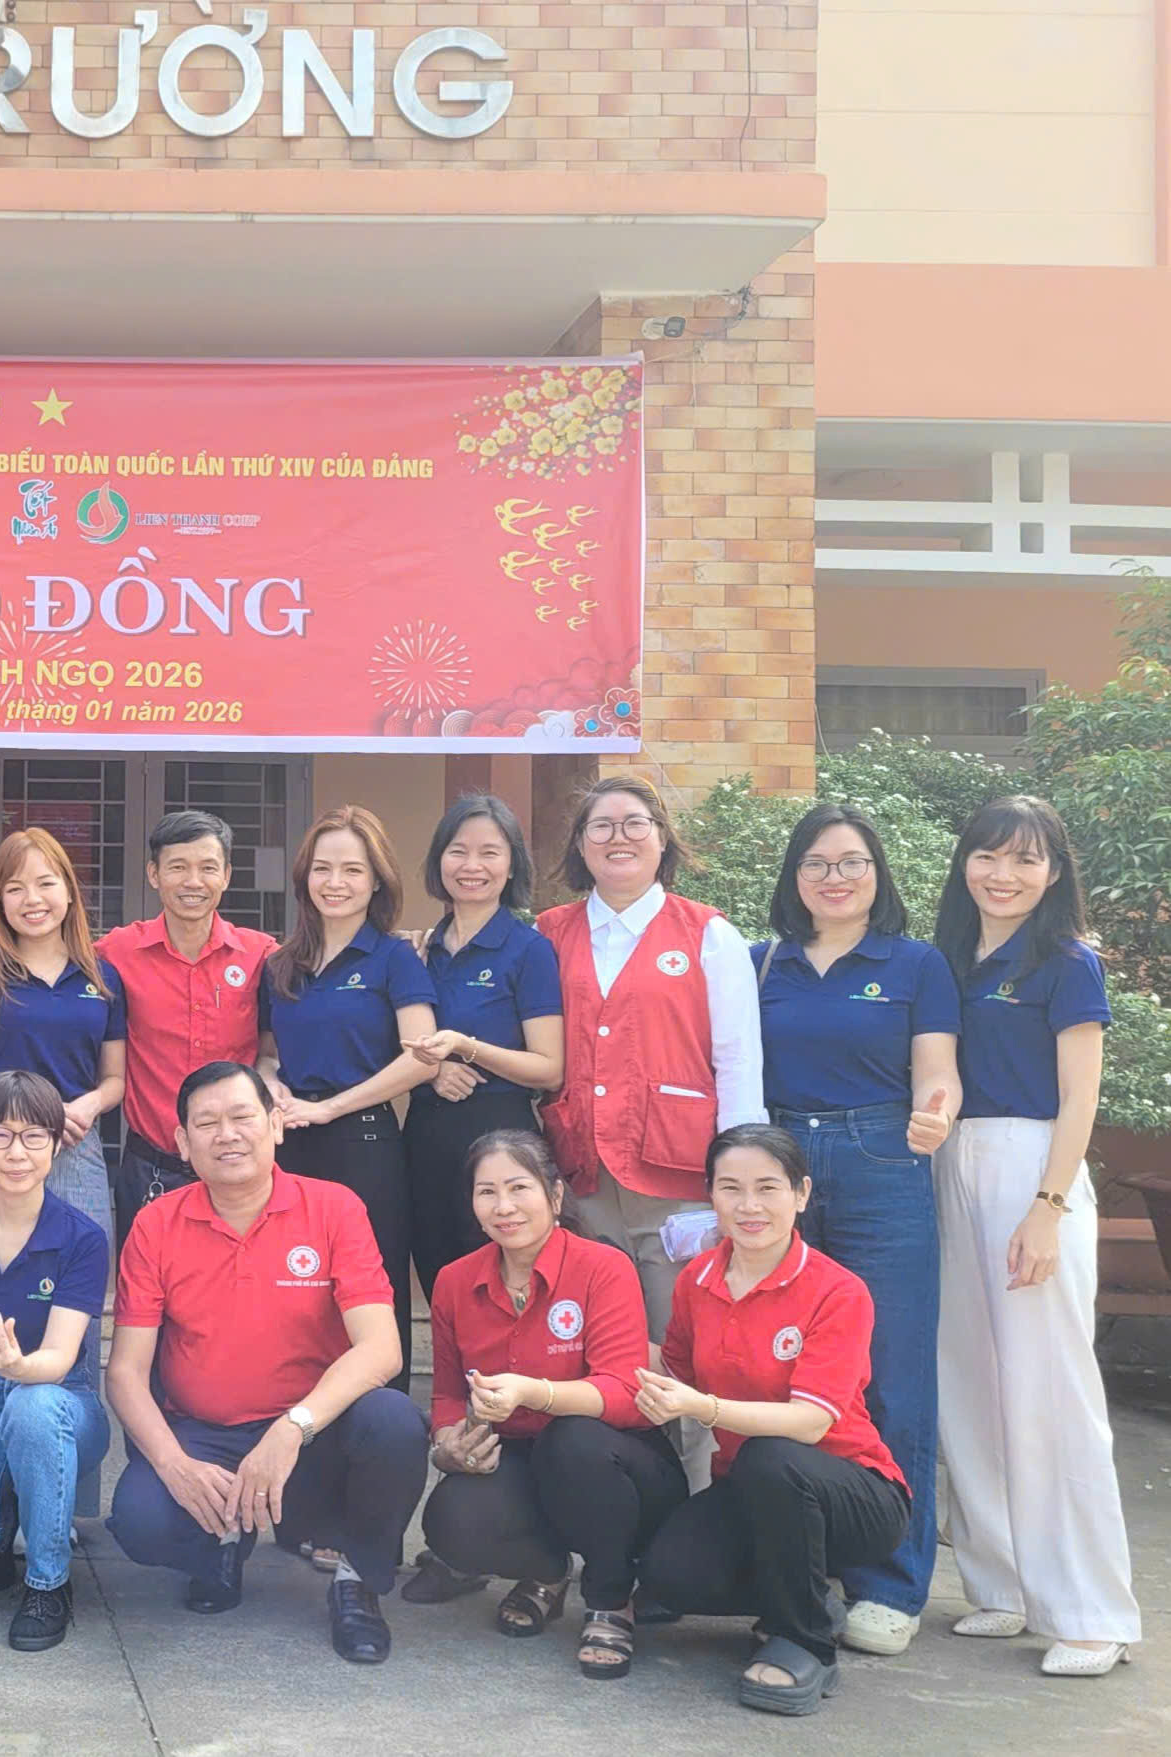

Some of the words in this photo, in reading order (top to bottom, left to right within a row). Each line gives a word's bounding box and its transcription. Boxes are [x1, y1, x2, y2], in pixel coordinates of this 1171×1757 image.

[53, 449, 110, 475] TOÀN
[117, 449, 175, 477] QUỐC
[182, 450, 225, 477] LẦN
[231, 453, 275, 478] THỨ
[279, 456, 315, 478] XIV
[321, 451, 366, 478] CỦA
[372, 452, 434, 479] ĐẢNG
[171, 513, 221, 527] THANH
[25, 546, 311, 637] ĐỒNG
[32, 659, 115, 693] NGỌ
[125, 661, 203, 688] 2026
[6, 698, 78, 725] tháng
[85, 700, 113, 721] 01
[122, 700, 176, 722] năm
[183, 701, 243, 723] 2026
